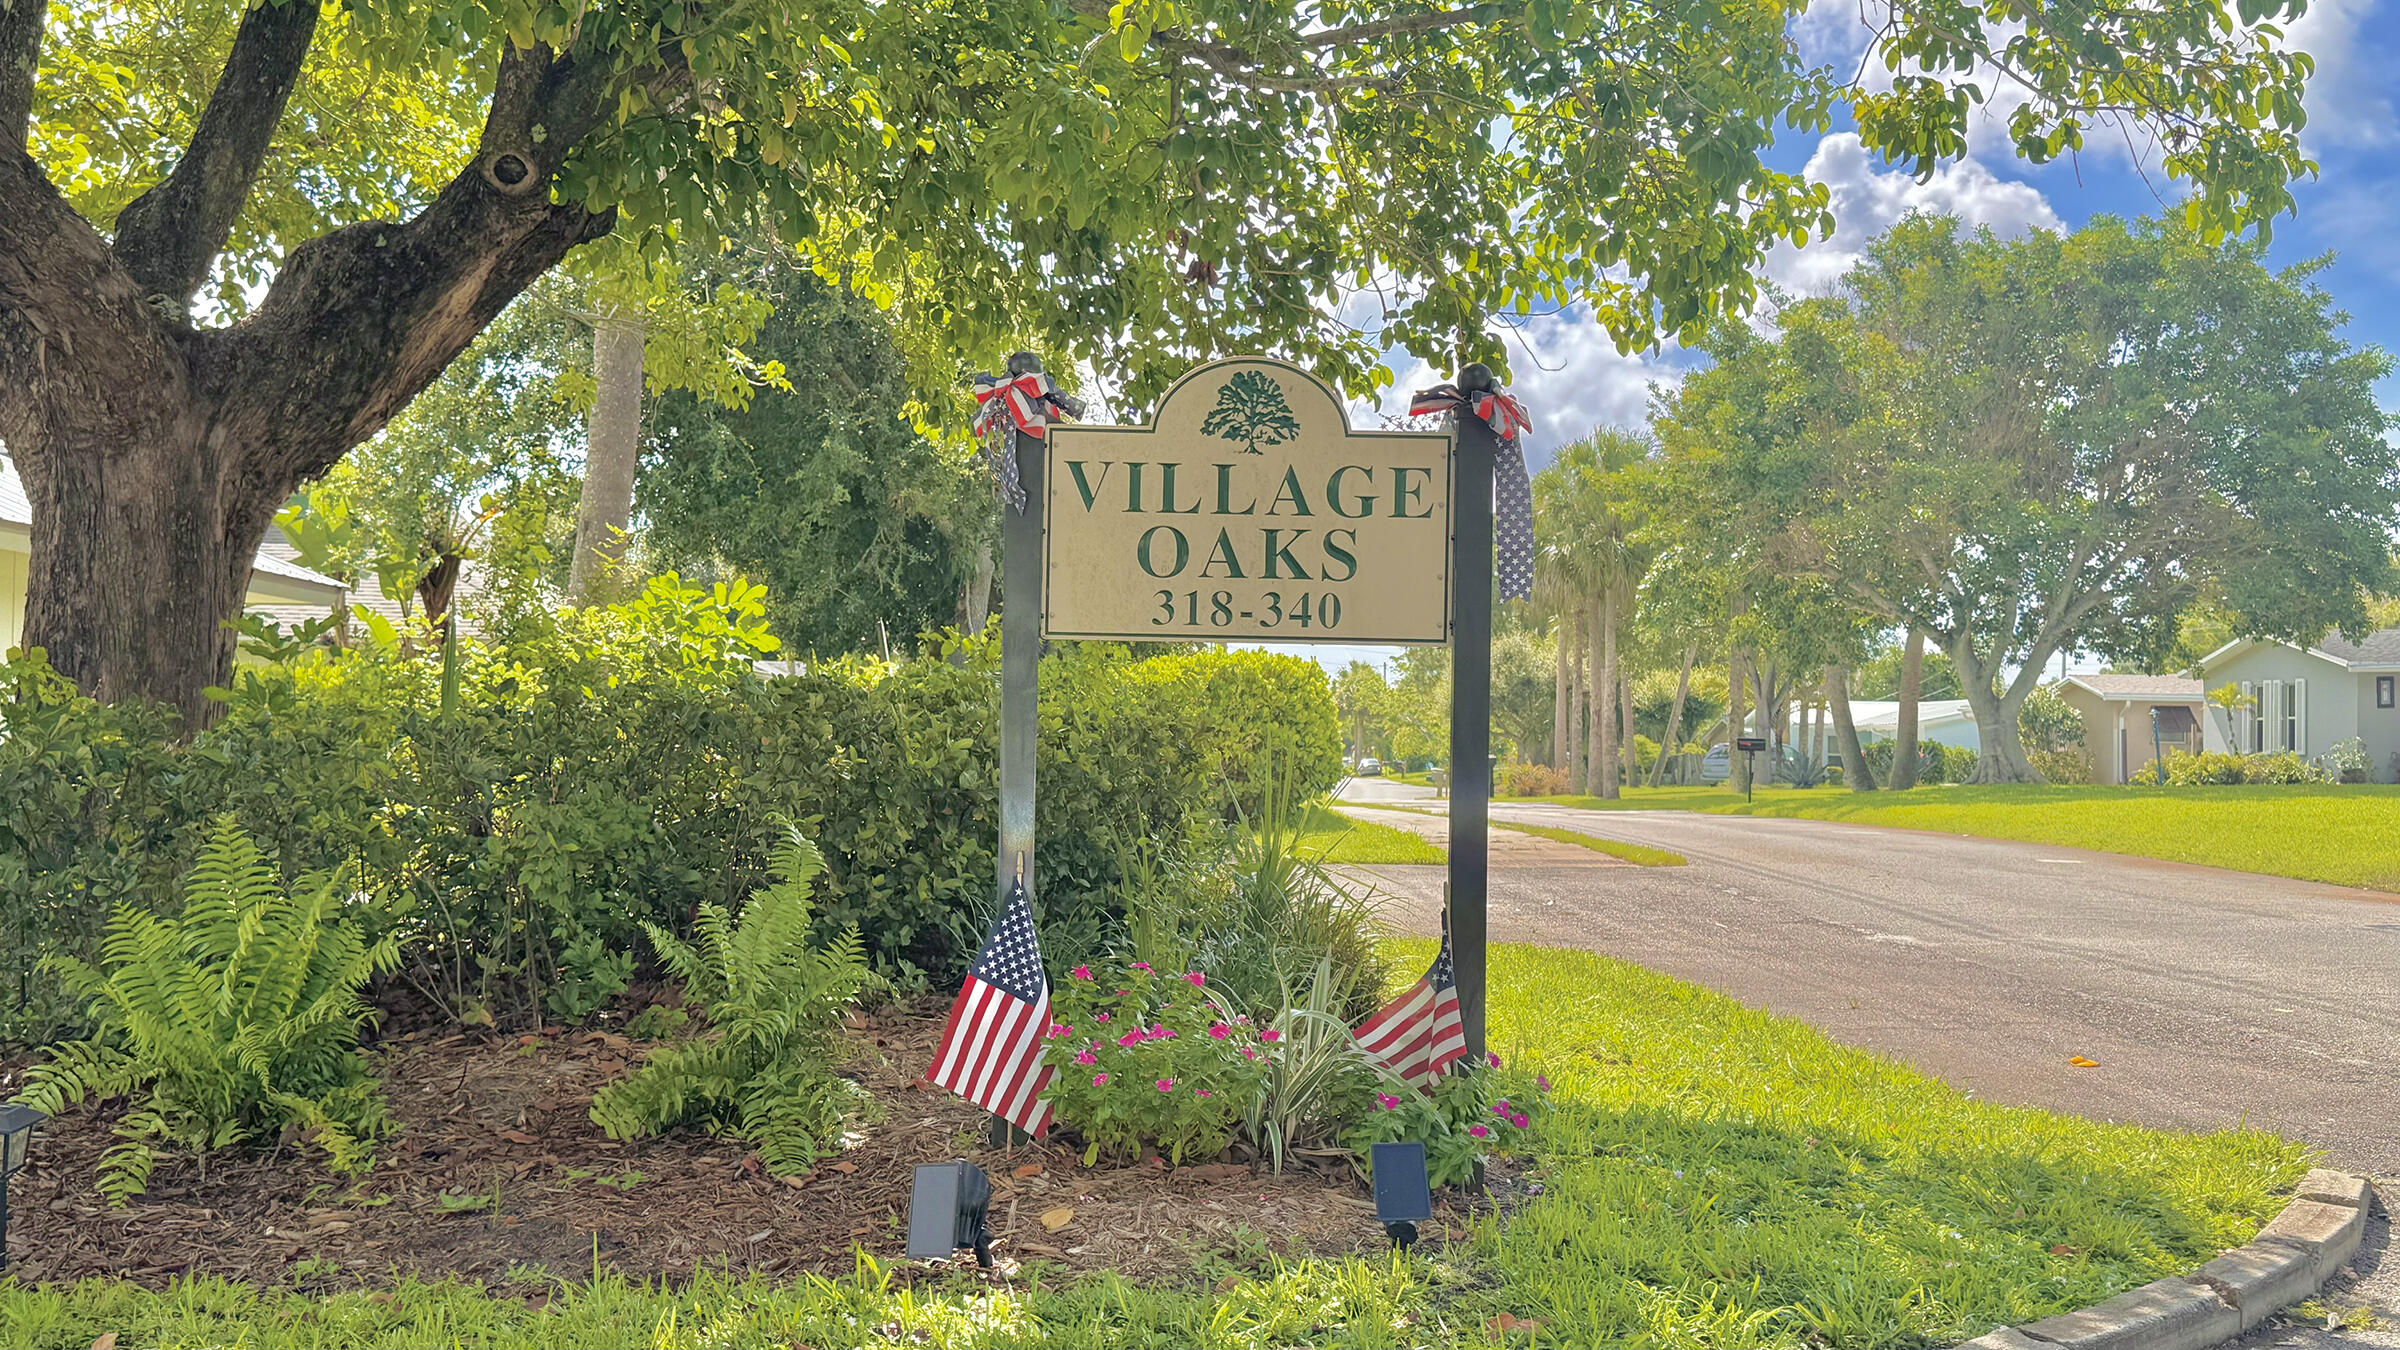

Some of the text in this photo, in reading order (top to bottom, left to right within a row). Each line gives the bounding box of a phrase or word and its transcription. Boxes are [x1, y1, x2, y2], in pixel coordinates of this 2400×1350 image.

[1064, 461, 1434, 519] VILLAGE
[1137, 525, 1358, 582] OAKS
[1151, 590, 1342, 629] 318-340
